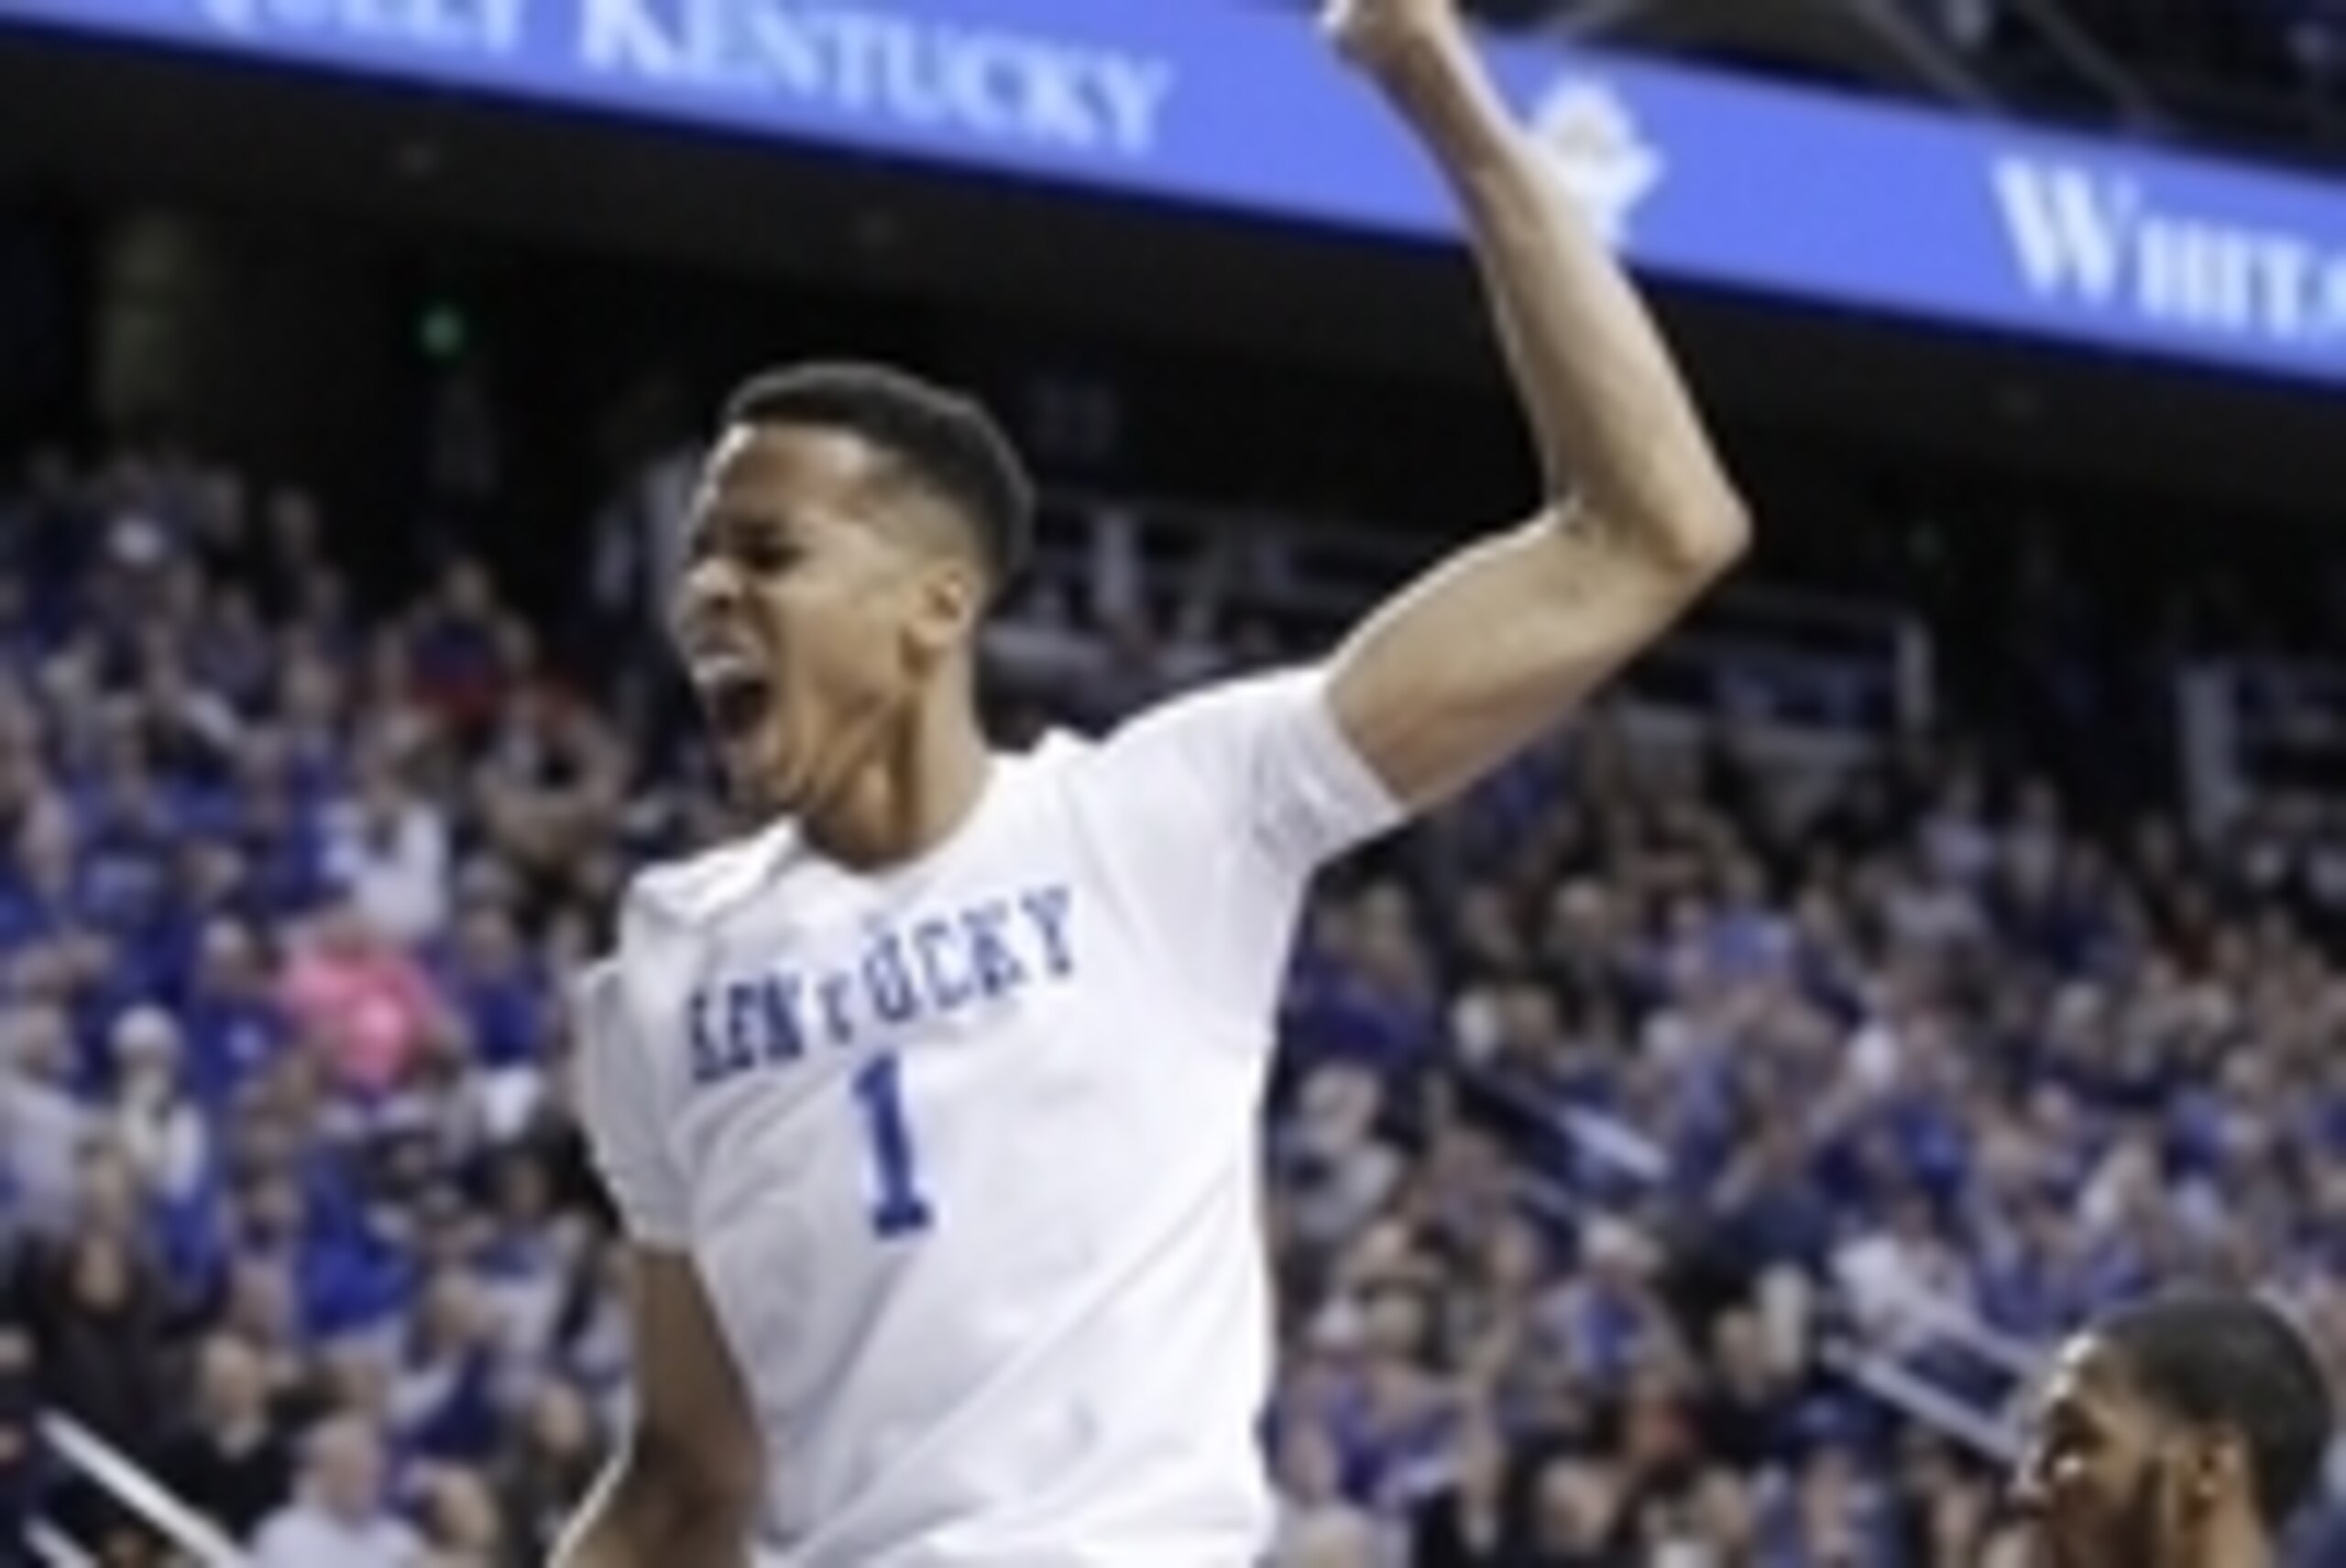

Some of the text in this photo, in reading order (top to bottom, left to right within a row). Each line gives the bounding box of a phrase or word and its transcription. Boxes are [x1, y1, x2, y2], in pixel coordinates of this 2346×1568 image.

[576, 0, 1173, 158] KENTUCKY
[689, 884, 1074, 1084] KENTUCKY
[852, 1052, 935, 1241] 1
